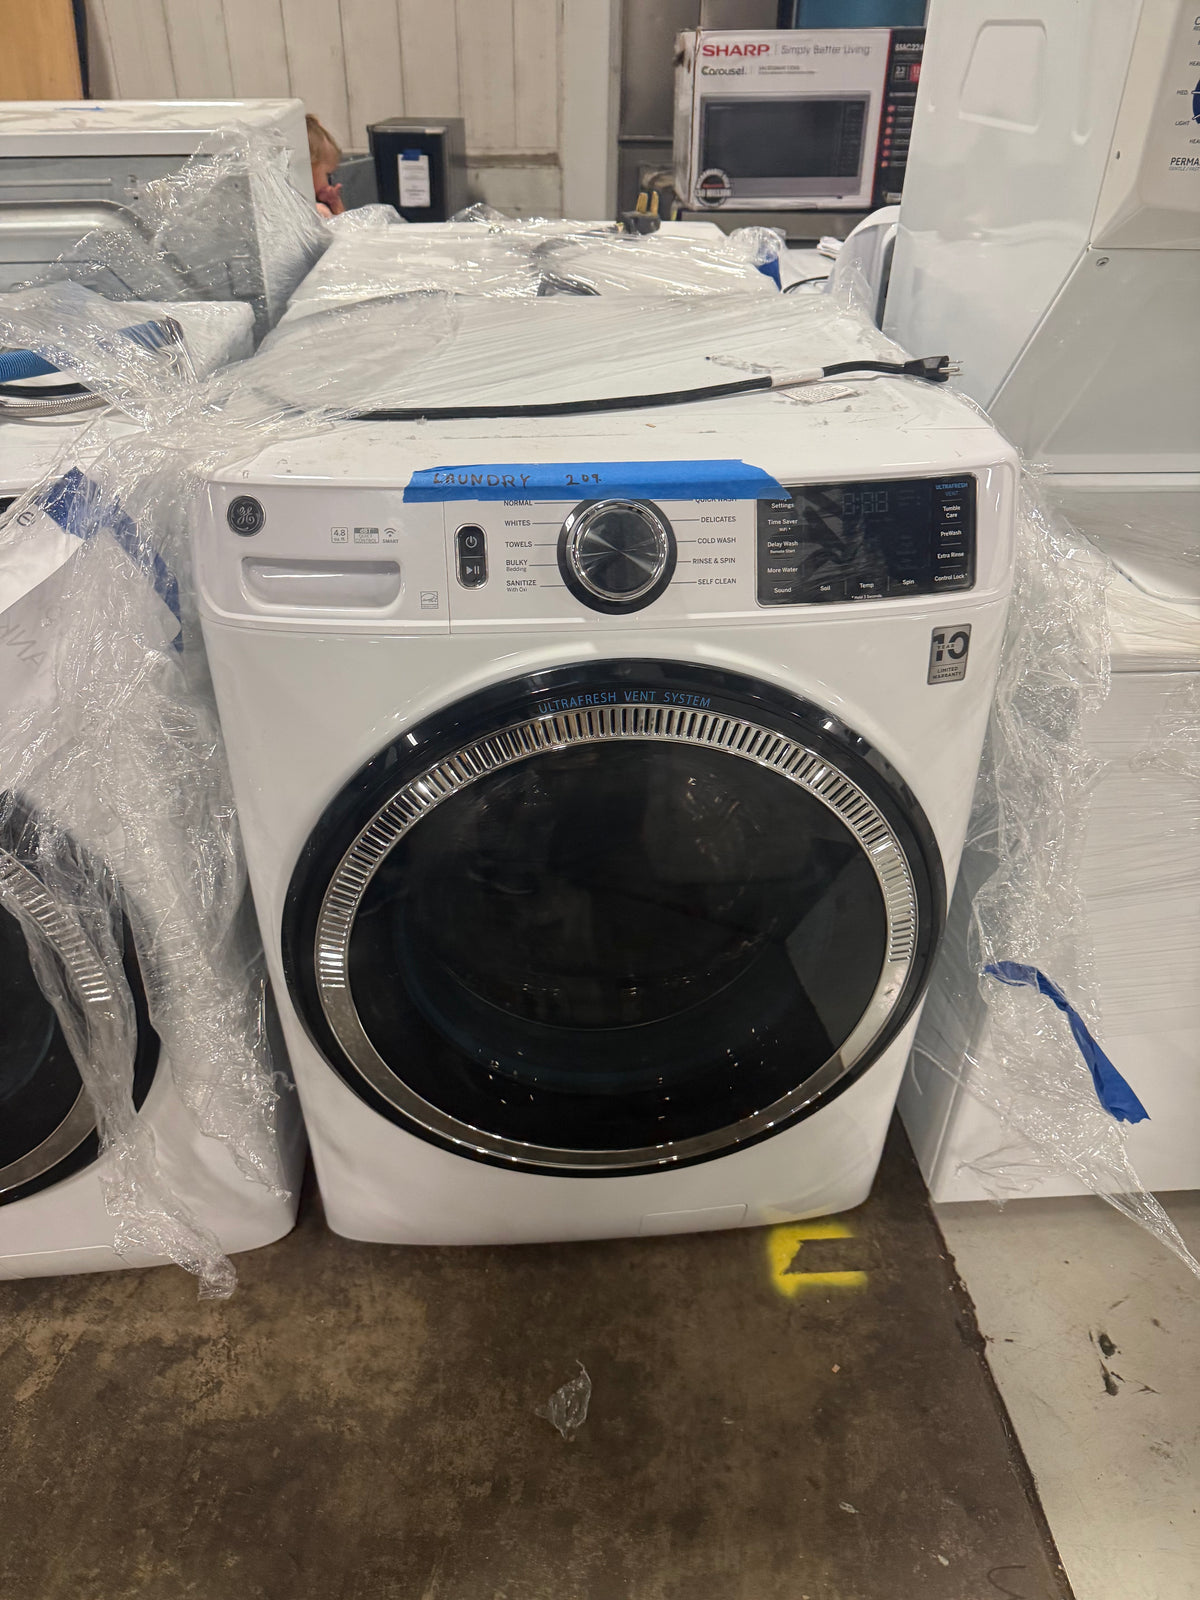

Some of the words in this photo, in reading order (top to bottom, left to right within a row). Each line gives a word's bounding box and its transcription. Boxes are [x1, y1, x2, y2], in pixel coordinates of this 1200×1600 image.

[702, 44, 770, 57] SHARP
[781, 46, 810, 56] Simply
[814, 46, 840, 55] Better
[844, 46, 870, 56] Living
[701, 66, 745, 75] Carousel
[1170, 157, 1200, 166] PERMA
[434, 473, 532, 489] LAUNDRY
[932, 631, 969, 662] 10
[538, 692, 617, 714] ULTRAFRESH
[624, 690, 656, 702] VENT
[664, 691, 711, 708] SYSTEM
